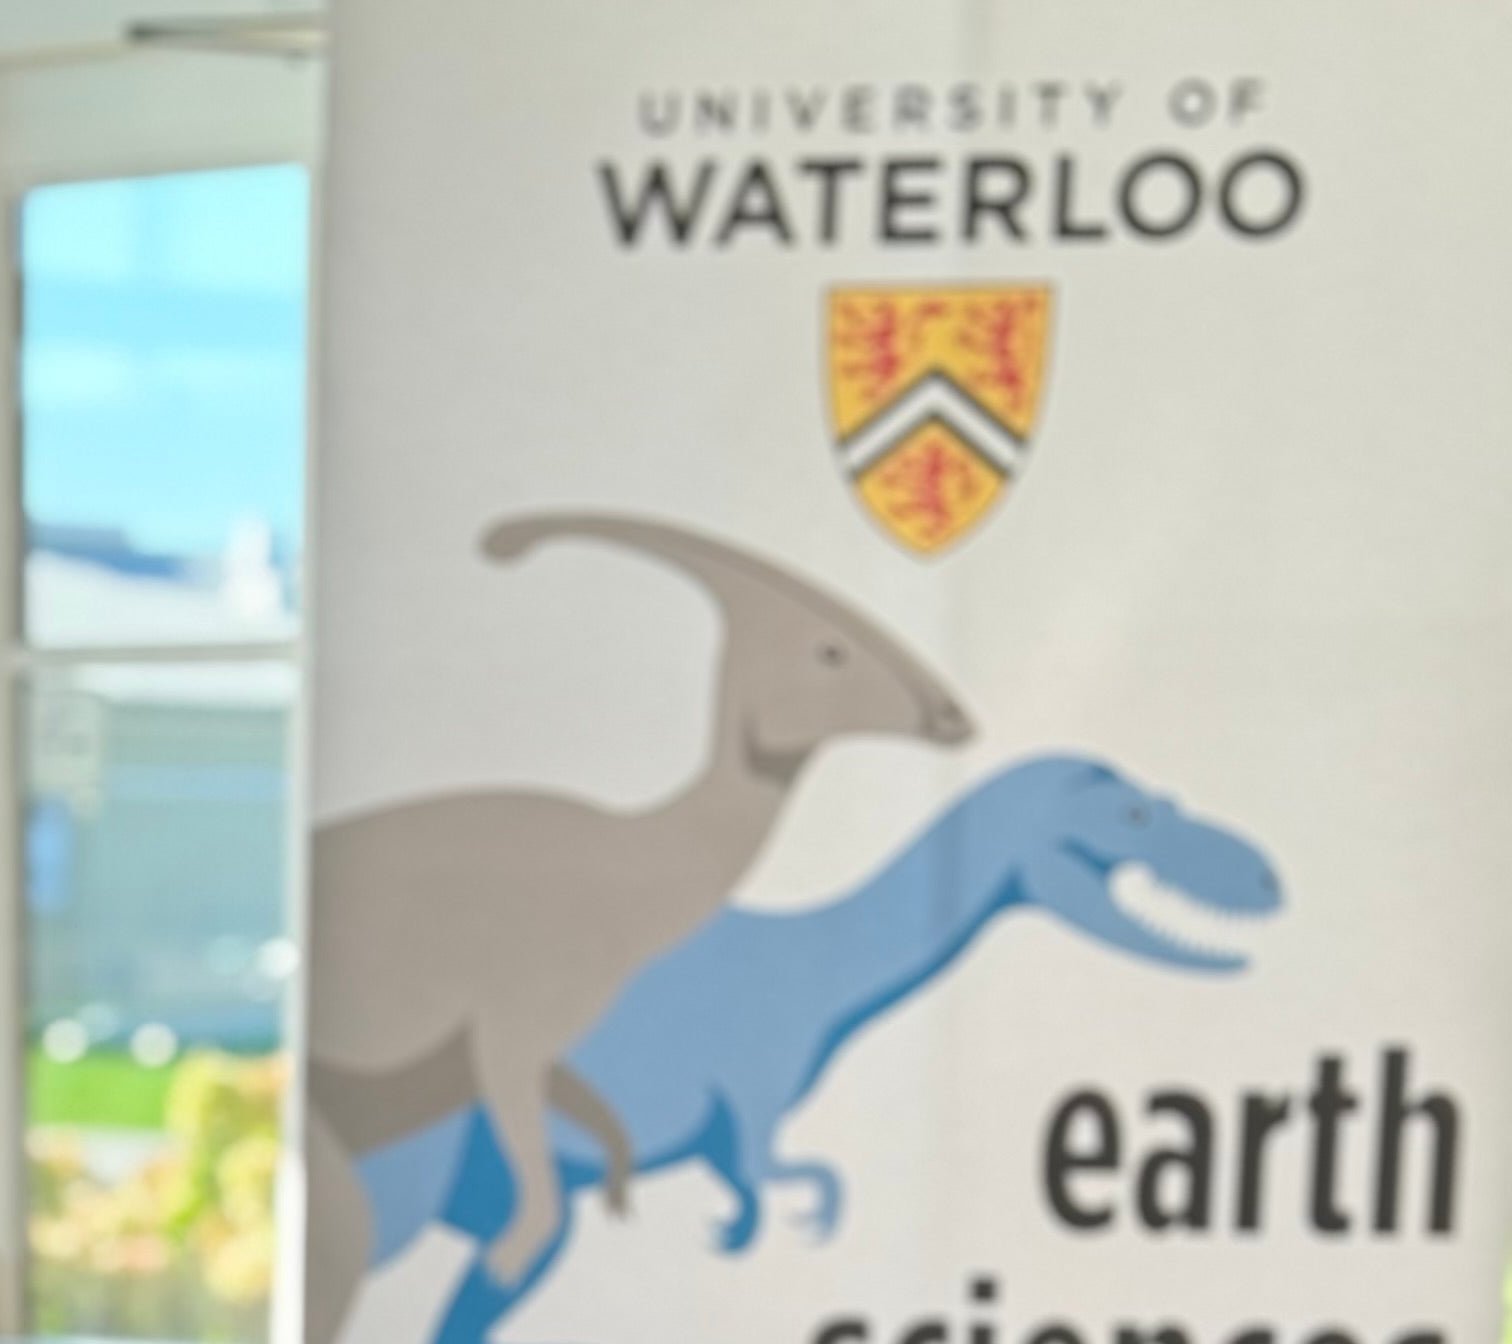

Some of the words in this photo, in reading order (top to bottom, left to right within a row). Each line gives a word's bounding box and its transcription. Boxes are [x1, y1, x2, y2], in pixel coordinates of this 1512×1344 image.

[639, 80, 1122, 136] UNIVERSITY
[1169, 77, 1266, 128] OF
[597, 148, 1309, 250] WATERLOO
[1042, 1047, 1462, 1236] earth
